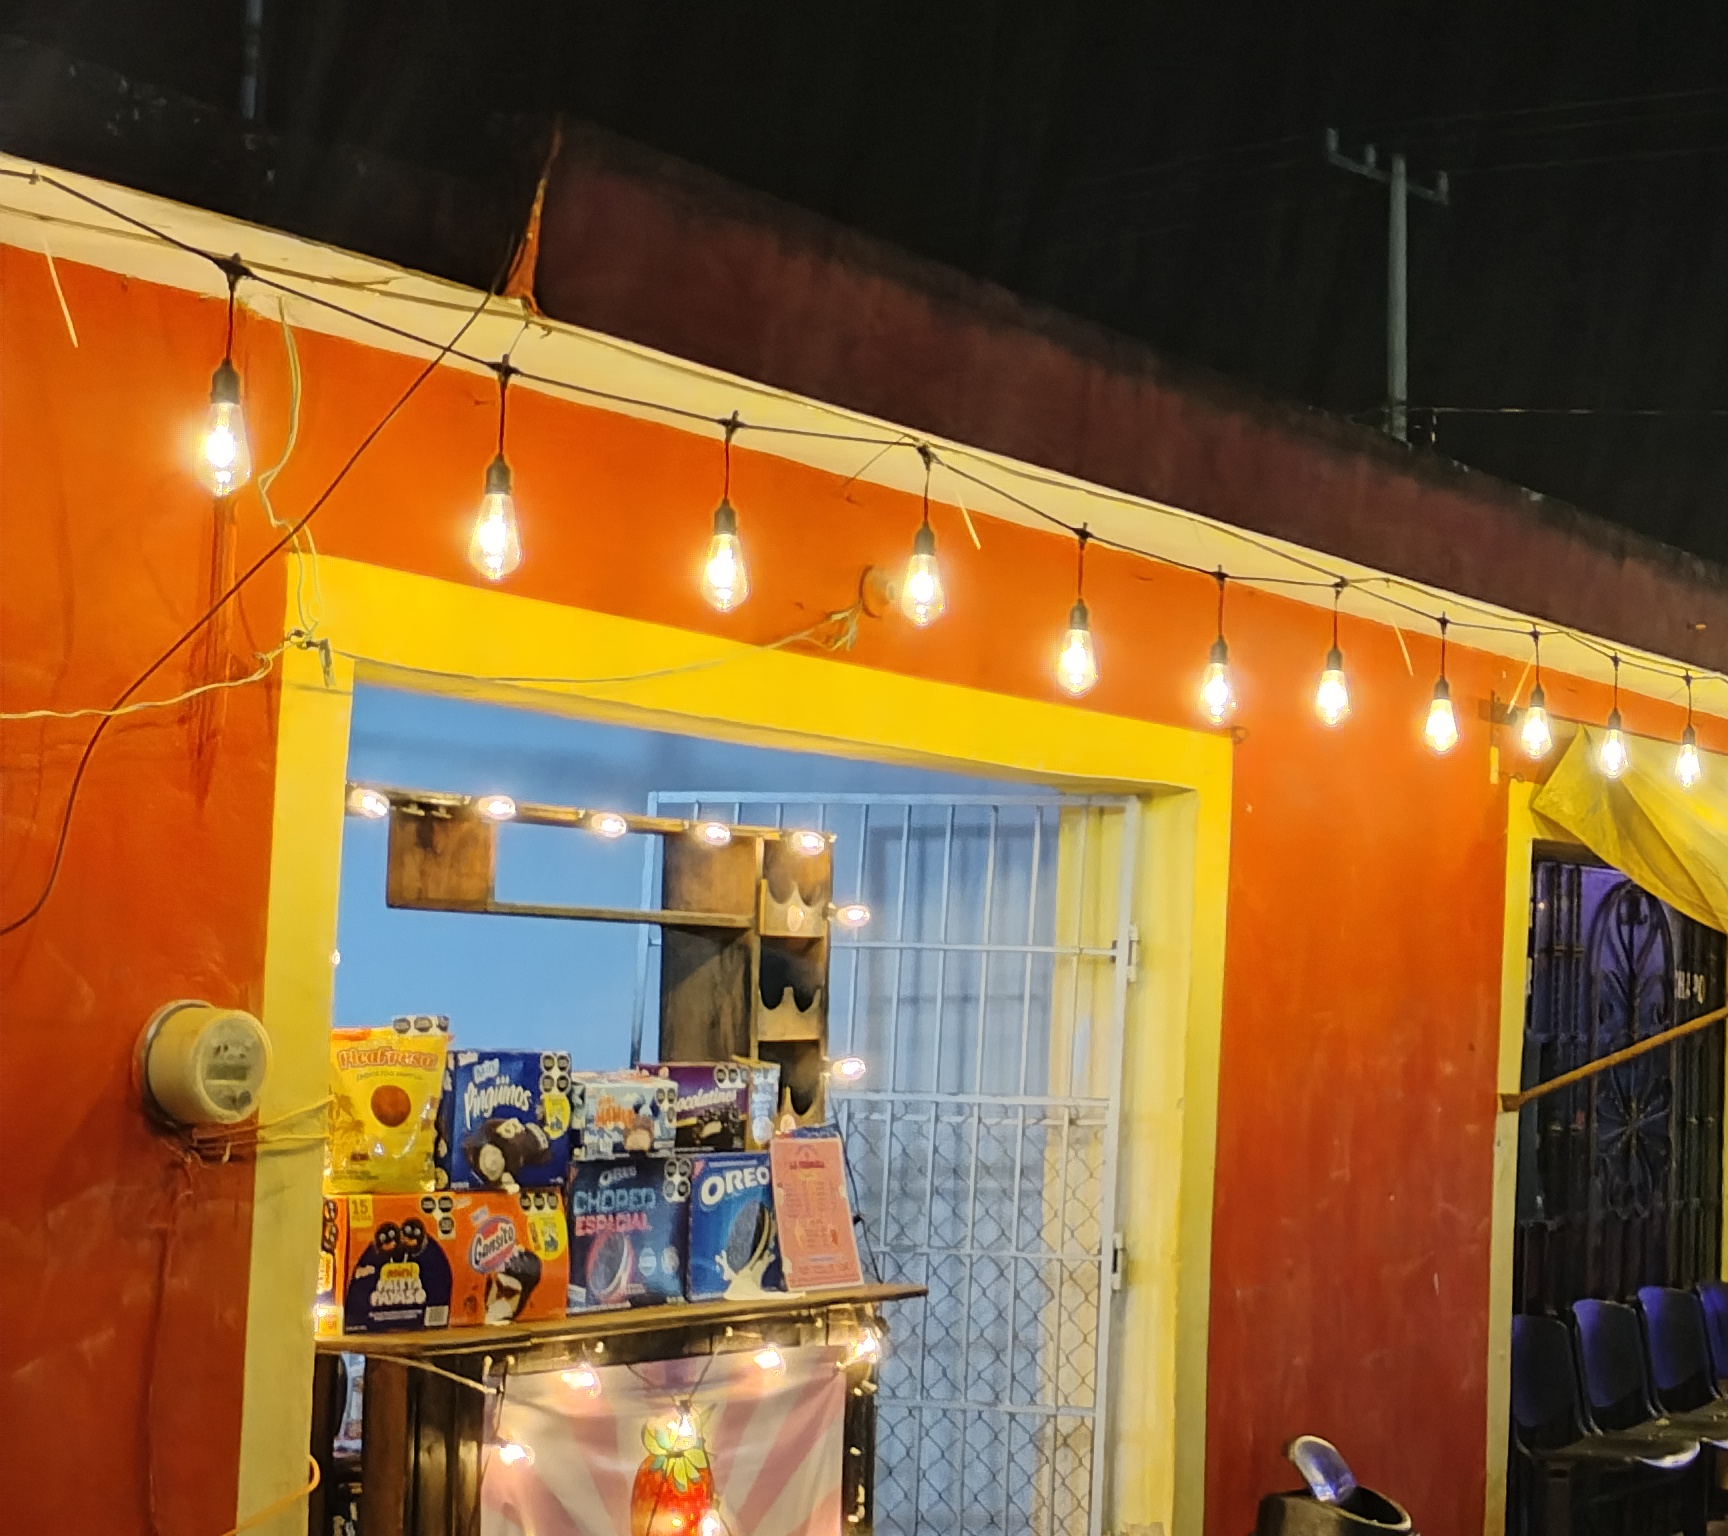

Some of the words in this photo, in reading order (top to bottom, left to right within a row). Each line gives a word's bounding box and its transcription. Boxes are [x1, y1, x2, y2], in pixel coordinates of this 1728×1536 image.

[351, 1199, 369, 1215] 15
[700, 1166, 771, 1207] OREO
[473, 1219, 515, 1265] Gansito
